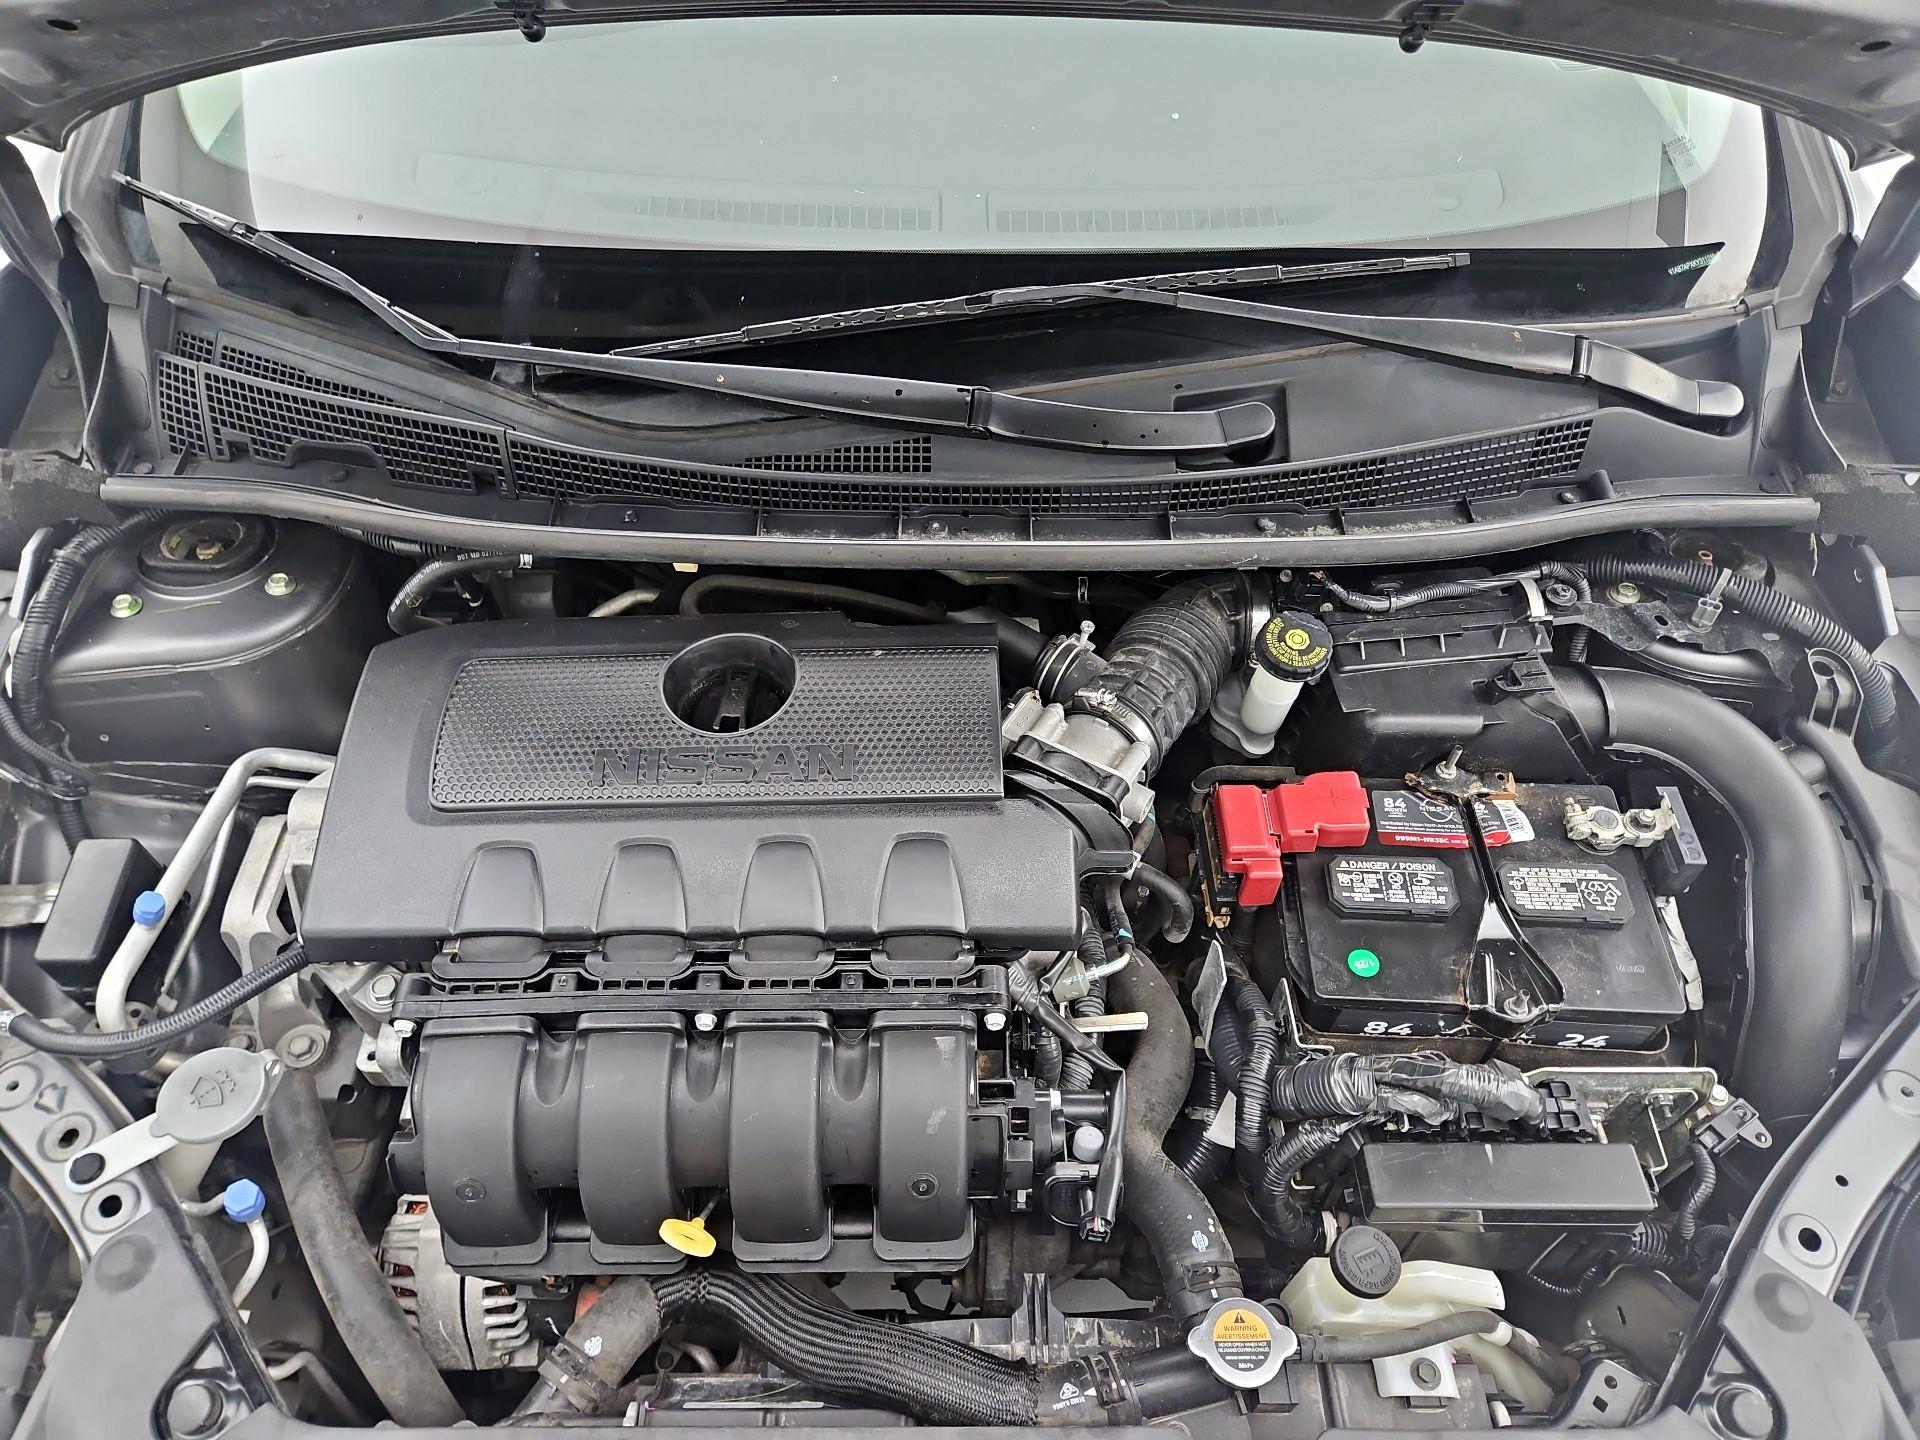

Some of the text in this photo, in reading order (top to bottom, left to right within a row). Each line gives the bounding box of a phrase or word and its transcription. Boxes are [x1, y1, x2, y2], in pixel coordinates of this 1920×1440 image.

[591, 744, 854, 787] NISSAN
[1383, 797, 1406, 808] 84
[1349, 860, 1389, 869] DANGER
[1400, 862, 1436, 871] POISON
[1363, 1022, 1414, 1037] 84
[1557, 1033, 1610, 1048] 24
